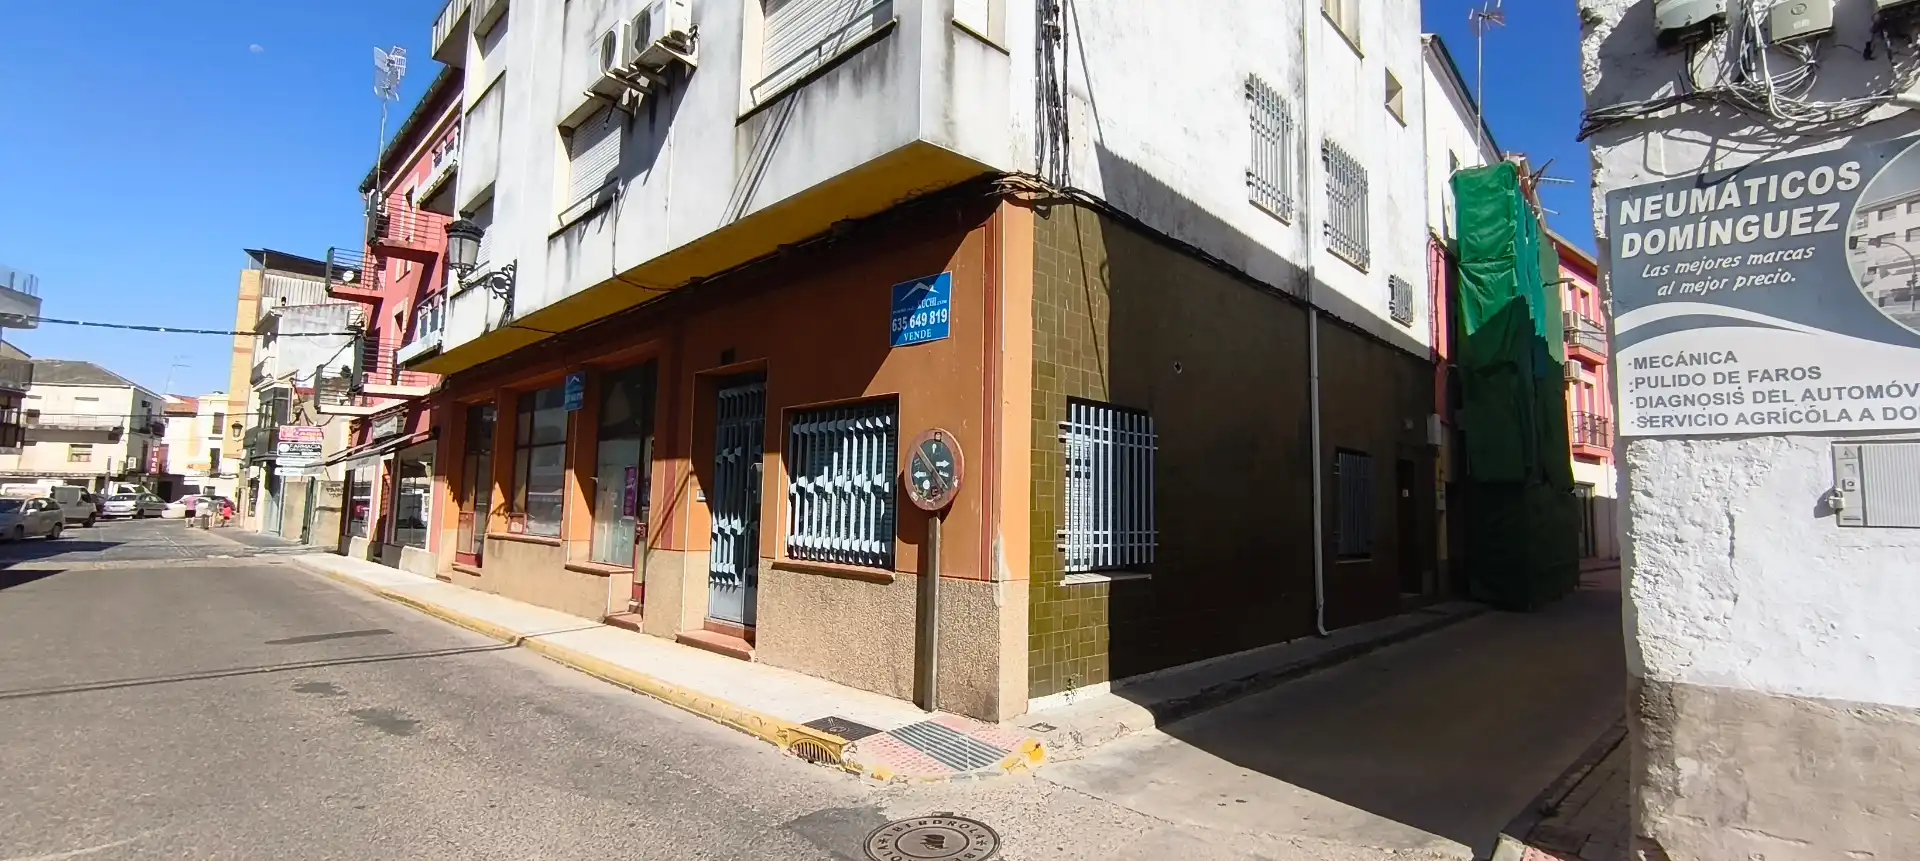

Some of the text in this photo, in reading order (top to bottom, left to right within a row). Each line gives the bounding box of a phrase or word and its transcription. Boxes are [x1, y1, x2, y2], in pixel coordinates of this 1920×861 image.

[1619, 161, 1861, 225] NEUMÁTICOS
[1621, 202, 1840, 259] DOMÍNGUEZ
[1643, 245, 1816, 278] Las mejores marcas
[1657, 271, 1796, 296] al mejor precio.
[892, 316, 907, 332] 635
[909, 312, 928, 328] 649
[929, 308, 947, 324] 819
[904, 328, 932, 340] VENDE
[1633, 350, 1738, 370] MECÁNICA
[1635, 366, 1822, 389] PULIDO DE FAROS
[1635, 391, 1745, 409] DIAGNOSIS
[1752, 389, 1795, 404] DEL
[1637, 405, 1920, 429] SERVICIO AGRÍCOLA A DO
[883, 819, 985, 840] IBERDROLA
